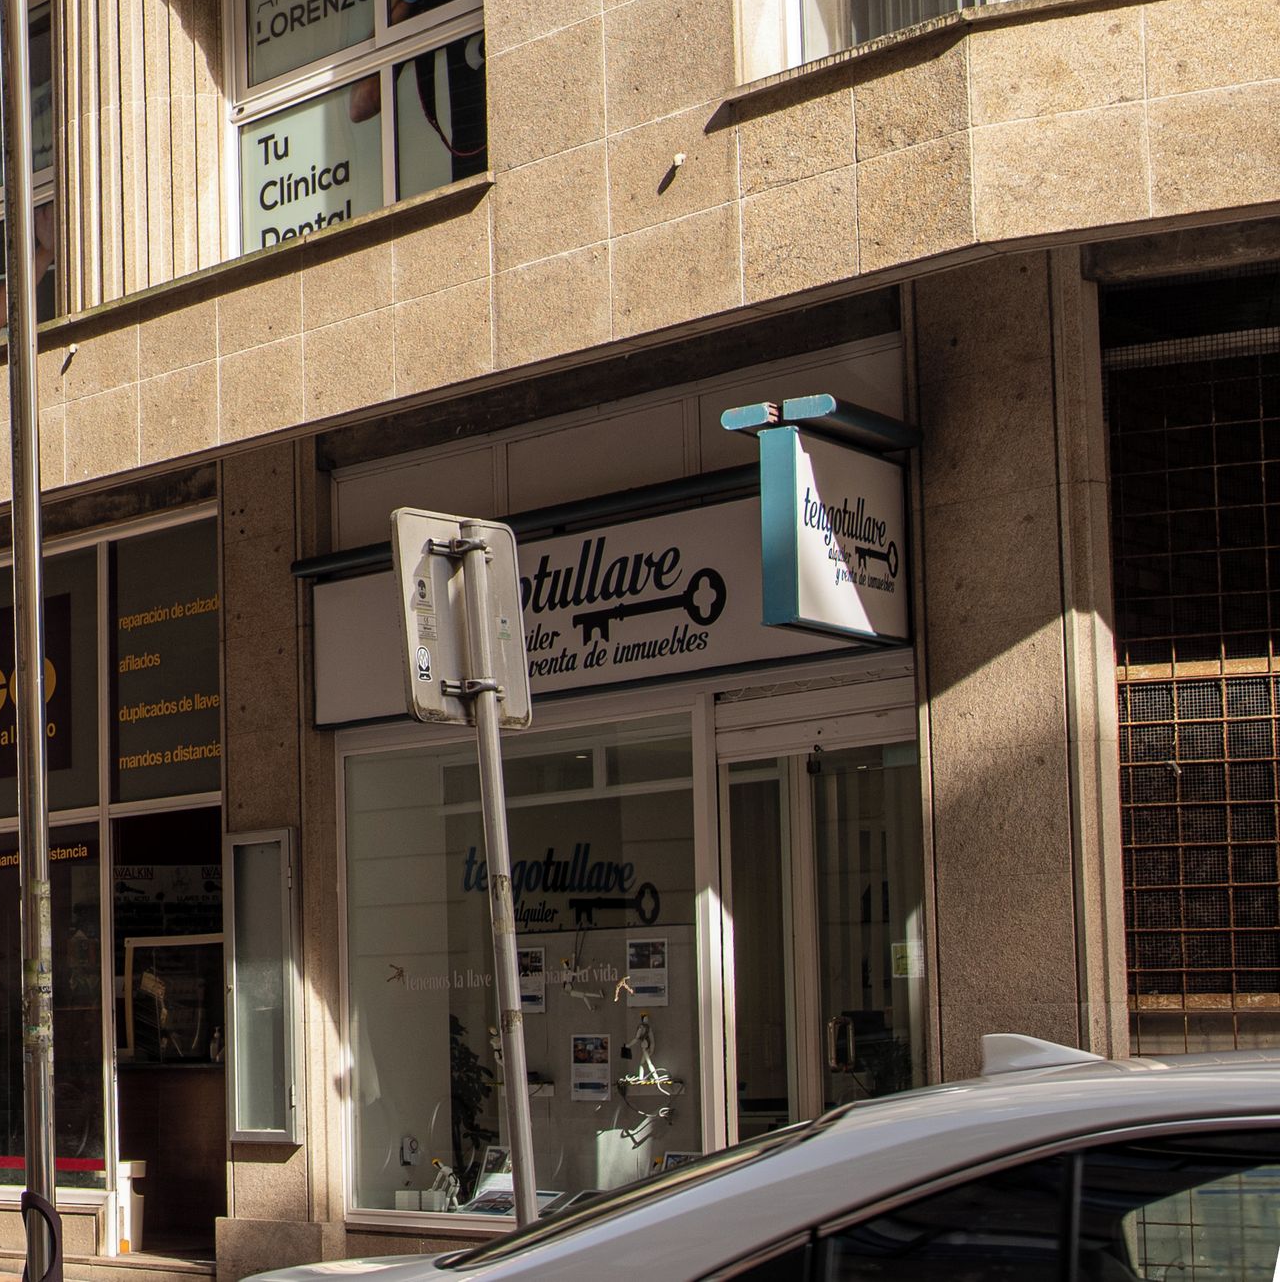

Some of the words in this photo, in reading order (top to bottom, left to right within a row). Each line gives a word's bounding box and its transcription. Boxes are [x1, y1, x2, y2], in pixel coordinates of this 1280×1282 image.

[258, 133, 289, 166] Tu
[260, 160, 350, 211] Clínica
[804, 487, 886, 547] tengotullave
[520, 537, 682, 614] otullave
[119, 606, 170, 632] reparación
[171, 603, 184, 619] de
[185, 593, 222, 617] calzad
[119, 652, 161, 673] afilados
[529, 647, 577, 678] venta
[584, 641, 608, 669] de
[613, 624, 709, 665] inmuebles
[119, 700, 177, 723] duplicados
[179, 696, 193, 713] de
[119, 749, 162, 769] mandos
[164, 751, 171, 763] a
[173, 740, 222, 762] distancia
[49, 844, 88, 860] istancia
[464, 843, 637, 905] tegotullave
[454, 969, 464, 989] la
[593, 964, 618, 981] vida
